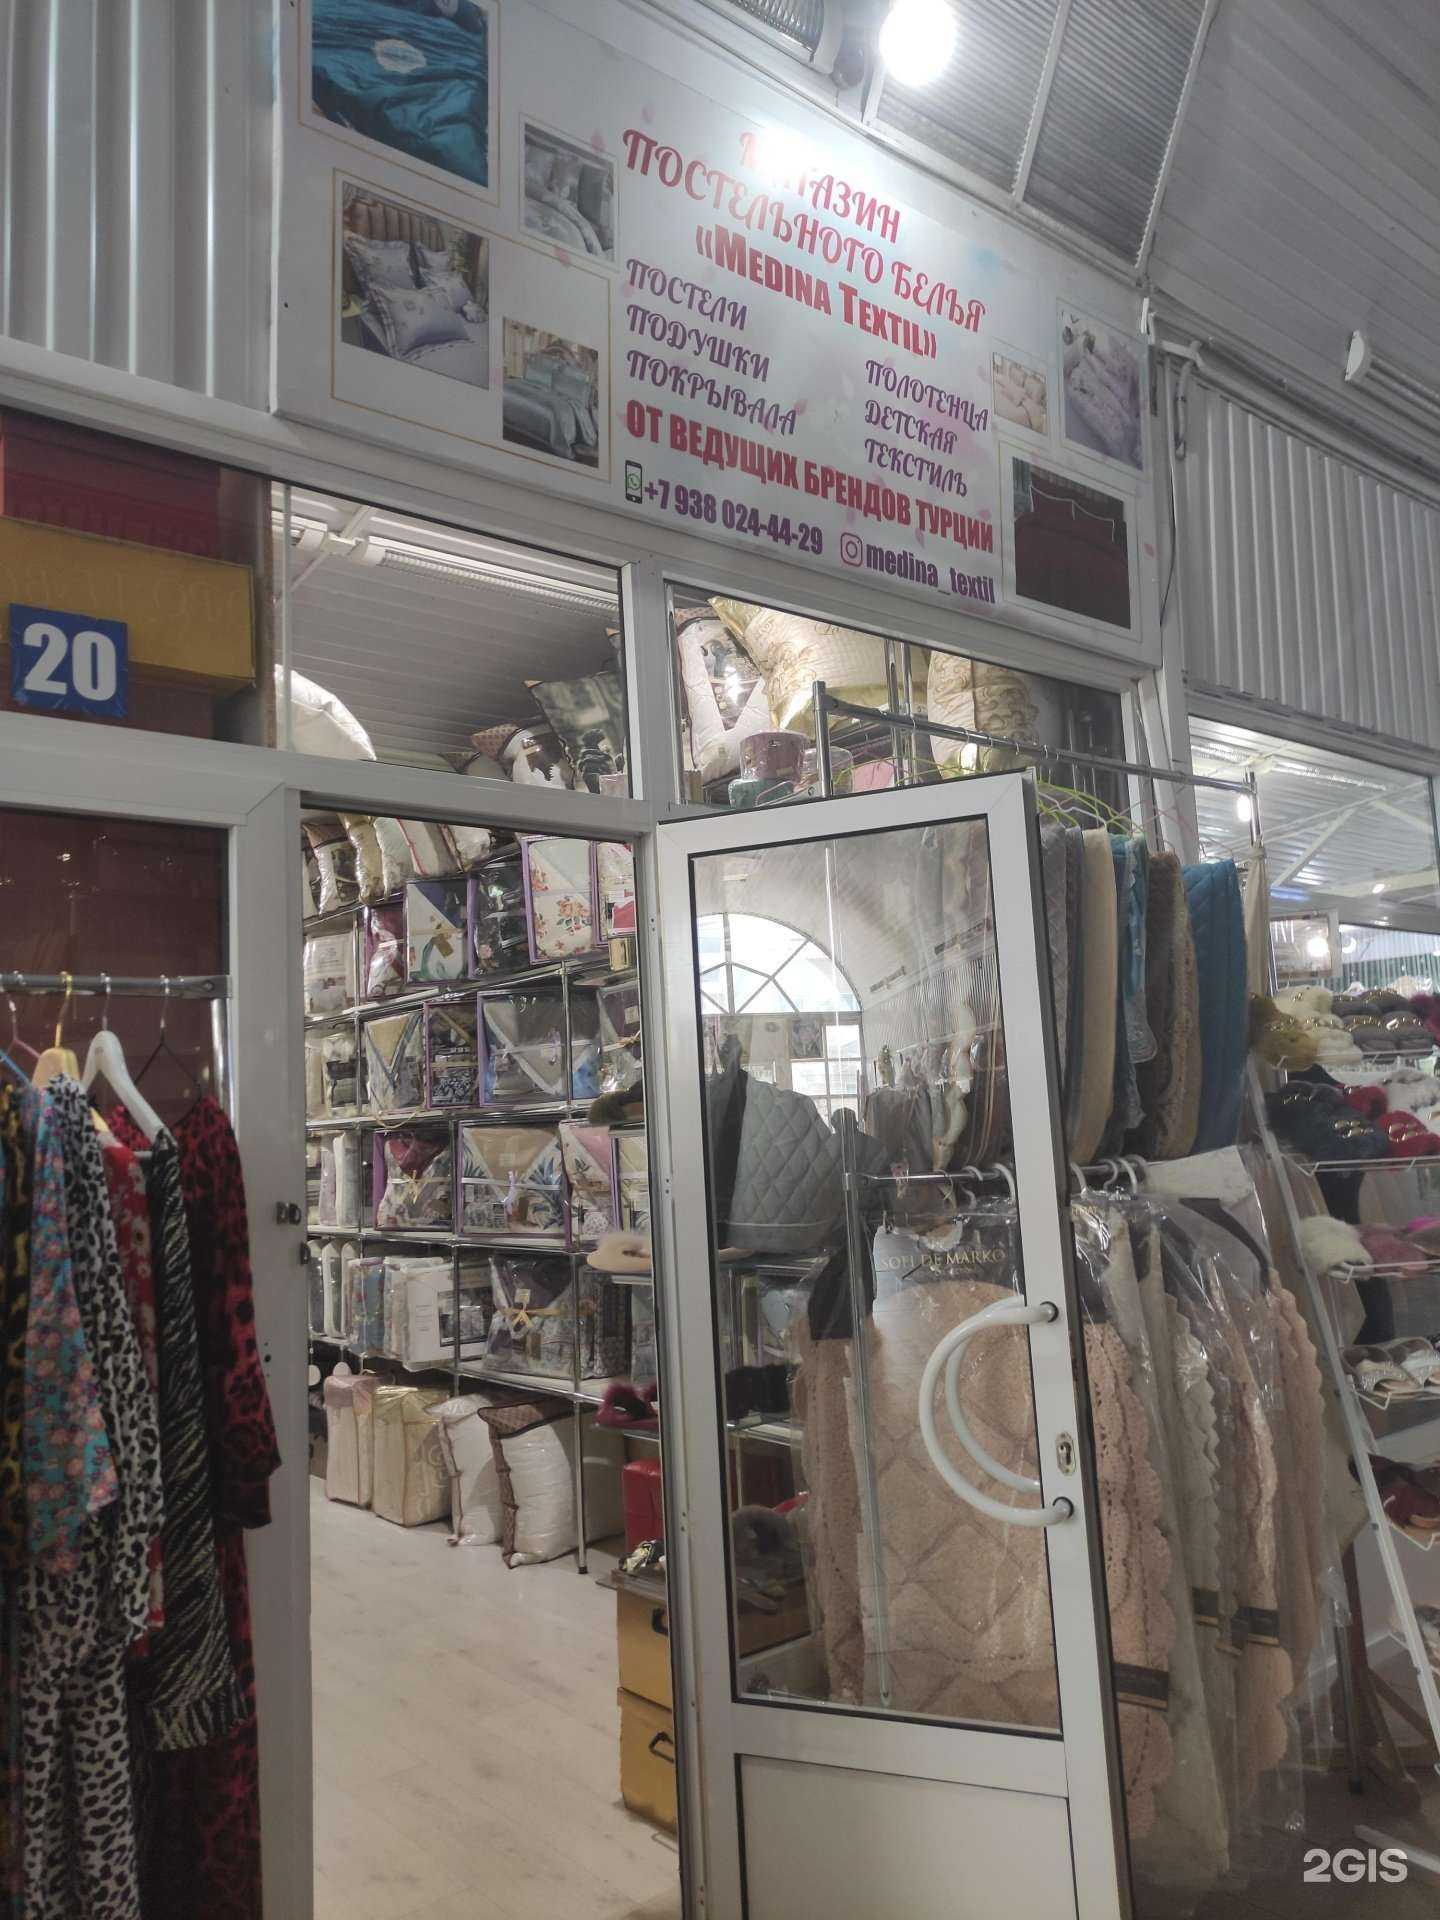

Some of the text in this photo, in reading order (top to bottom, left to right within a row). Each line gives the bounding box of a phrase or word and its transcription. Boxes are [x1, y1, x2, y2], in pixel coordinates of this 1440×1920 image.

[623, 129, 986, 333] ПОСТЕЛЬНОГО БЕЛЬЯ
[626, 258, 747, 331] ПОСТЕЛИ
[627, 304, 770, 382] ПОДУШКИ
[627, 349, 797, 435] ПОКРЫВАЛА
[865, 400, 957, 455] ДЕТСКАЯ
[866, 359, 989, 431] ПОЛОТЕНЦА
[626, 399, 993, 553] ОТ ВЕДУЩИХ БРЕНДОВ ТУРЦИИ
[865, 438, 967, 497] ТЕКСТИЛЬ
[643, 479, 824, 555] +7 938 024-44-29
[866, 546, 995, 603] medina_textil
[23, 622, 117, 702] 20
